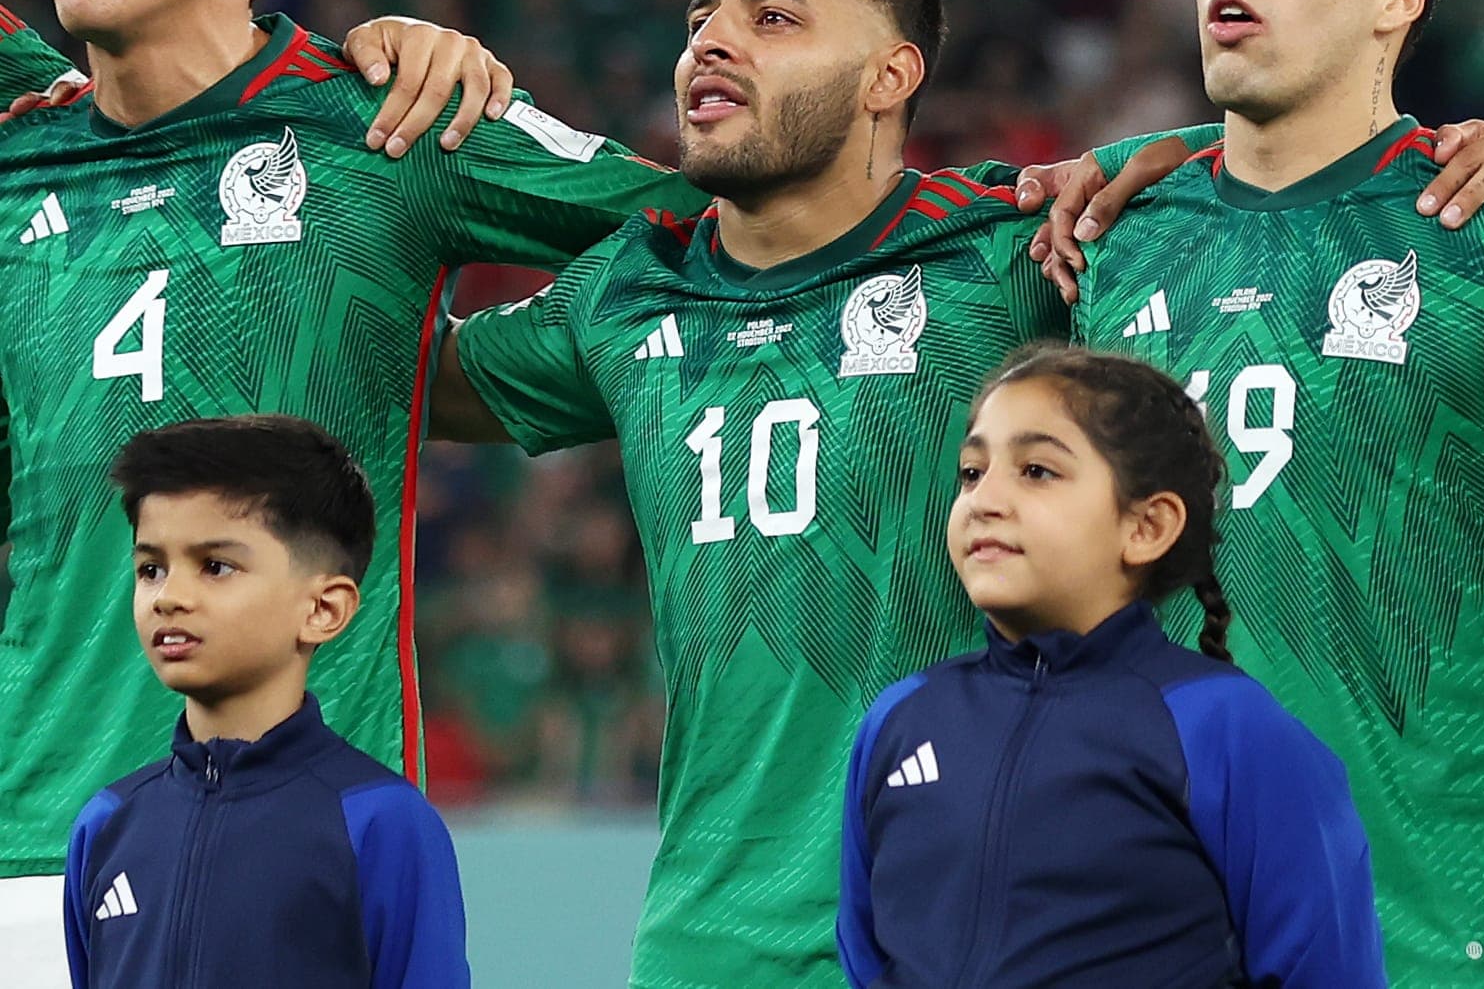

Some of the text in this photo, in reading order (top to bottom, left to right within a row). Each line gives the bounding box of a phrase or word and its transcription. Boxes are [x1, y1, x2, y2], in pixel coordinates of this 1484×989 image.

[224, 223, 298, 243] MÉXICO
[93, 270, 169, 402] 4
[1325, 335, 1402, 359] MÉXICO
[843, 354, 914, 373] MÉXICO
[685, 399, 820, 544] 10
